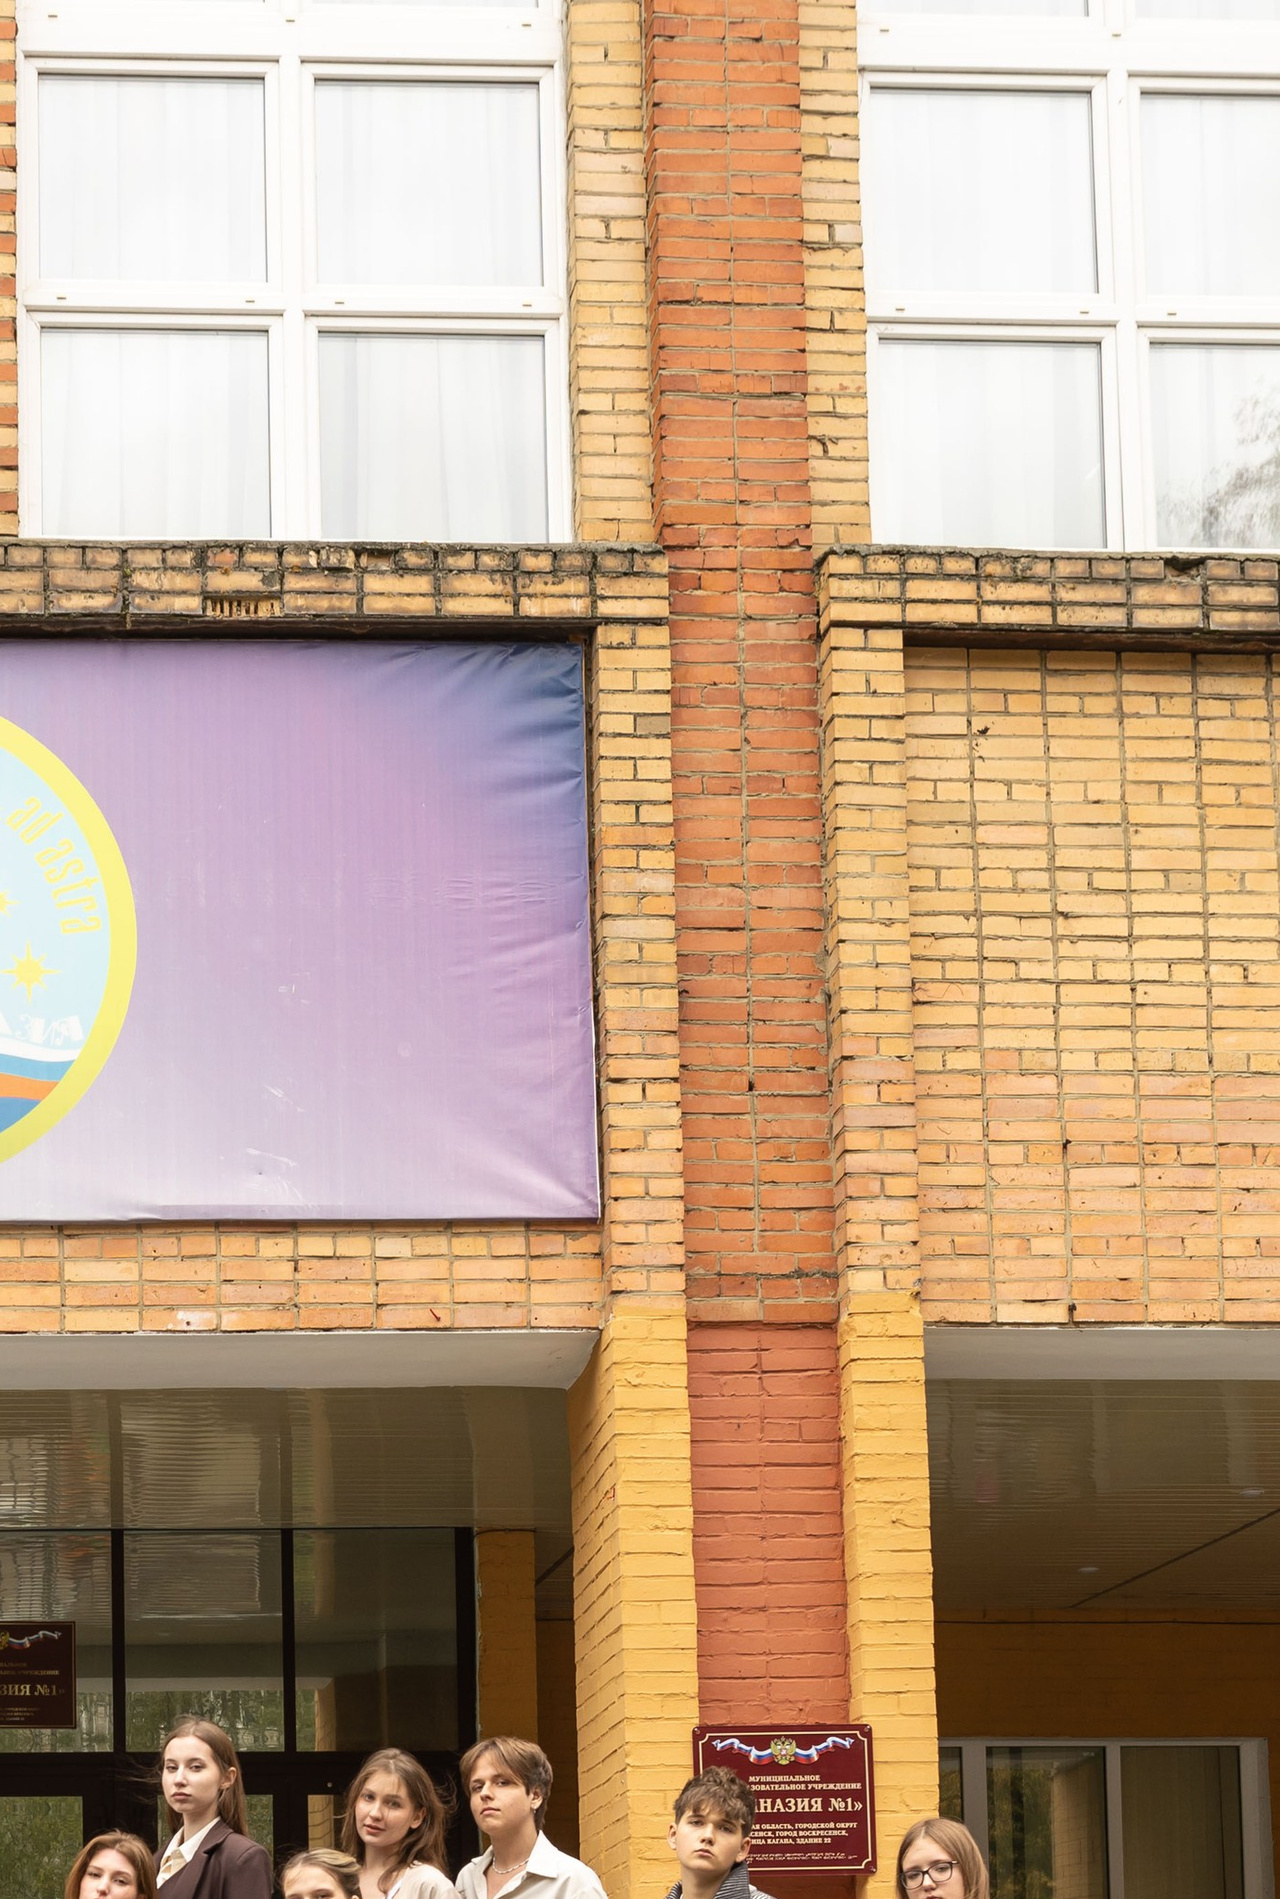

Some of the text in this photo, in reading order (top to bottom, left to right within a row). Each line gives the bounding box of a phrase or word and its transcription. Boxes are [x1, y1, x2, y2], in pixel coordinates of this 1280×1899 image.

[5, 796, 102, 935] ad astra
[748, 1774, 821, 1783] МУНИЦИПАЛЬНОЕ
[748, 1782, 862, 1791] ЗОВАТЕЛЬНОЕ УЧРЕЖДЕНИЕ
[754, 1797, 864, 1813] НАЗИЯ №1»
[794, 1821, 835, 1830] ГОРОДСКОЙ
